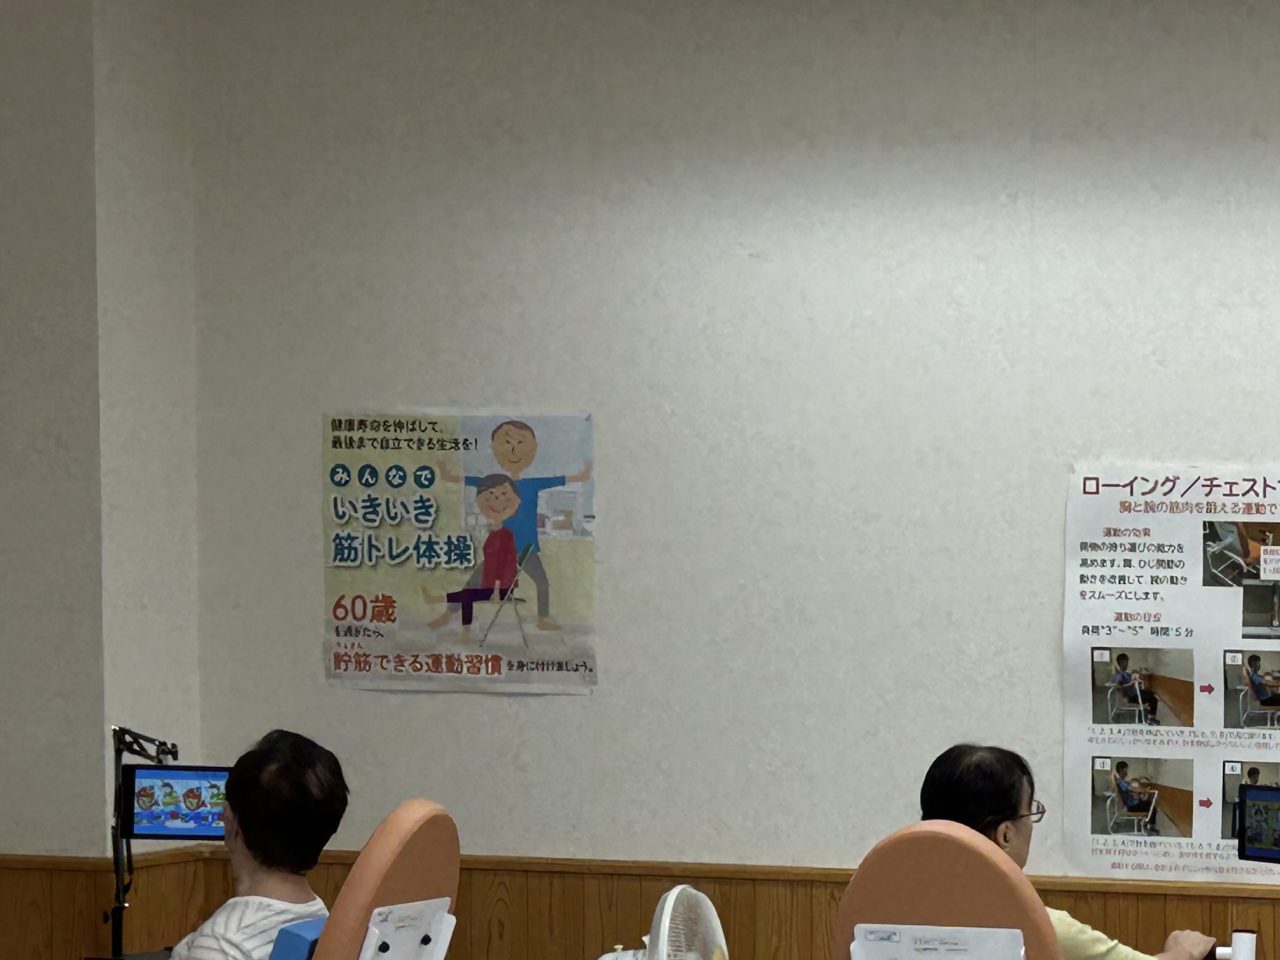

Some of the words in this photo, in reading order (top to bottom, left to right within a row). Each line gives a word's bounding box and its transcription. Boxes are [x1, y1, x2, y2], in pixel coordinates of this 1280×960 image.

[332, 465, 433, 487] みんなで
[332, 495, 437, 525] いきいき
[332, 532, 473, 566] 筋トレ体操
[332, 594, 397, 624] 60歳
